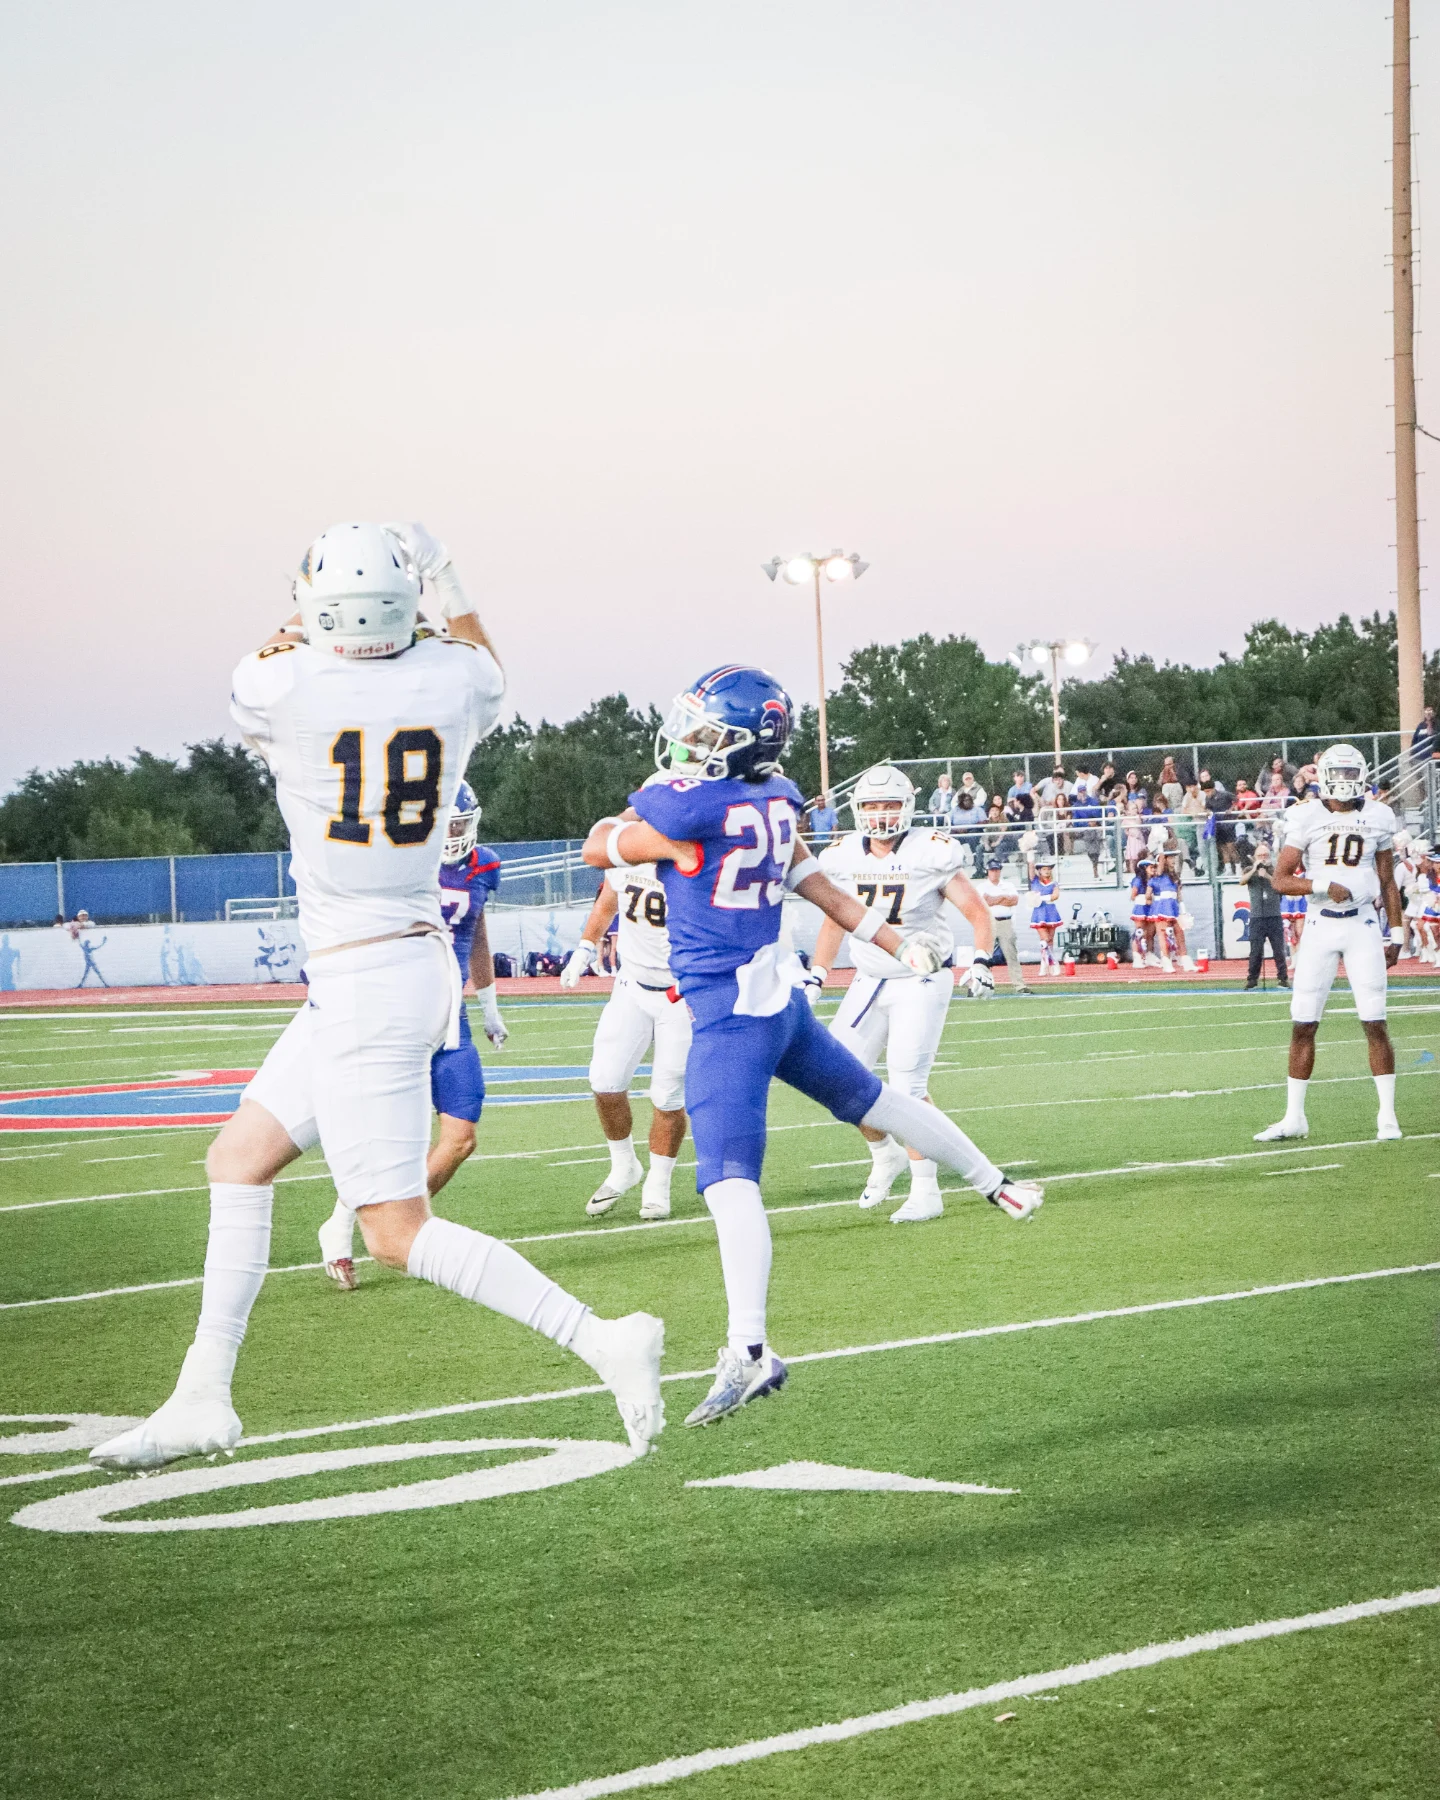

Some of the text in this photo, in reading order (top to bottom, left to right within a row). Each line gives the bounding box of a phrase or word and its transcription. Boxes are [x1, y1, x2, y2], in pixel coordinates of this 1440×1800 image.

[325, 726, 444, 847] 18
[1323, 825, 1372, 833] PRESTONWOOD
[1324, 833, 1365, 867] 10
[710, 796, 797, 910] 29
[852, 873, 910, 881] PRESTONWOOD
[624, 884, 667, 928] 78
[857, 883, 906, 926] 77
